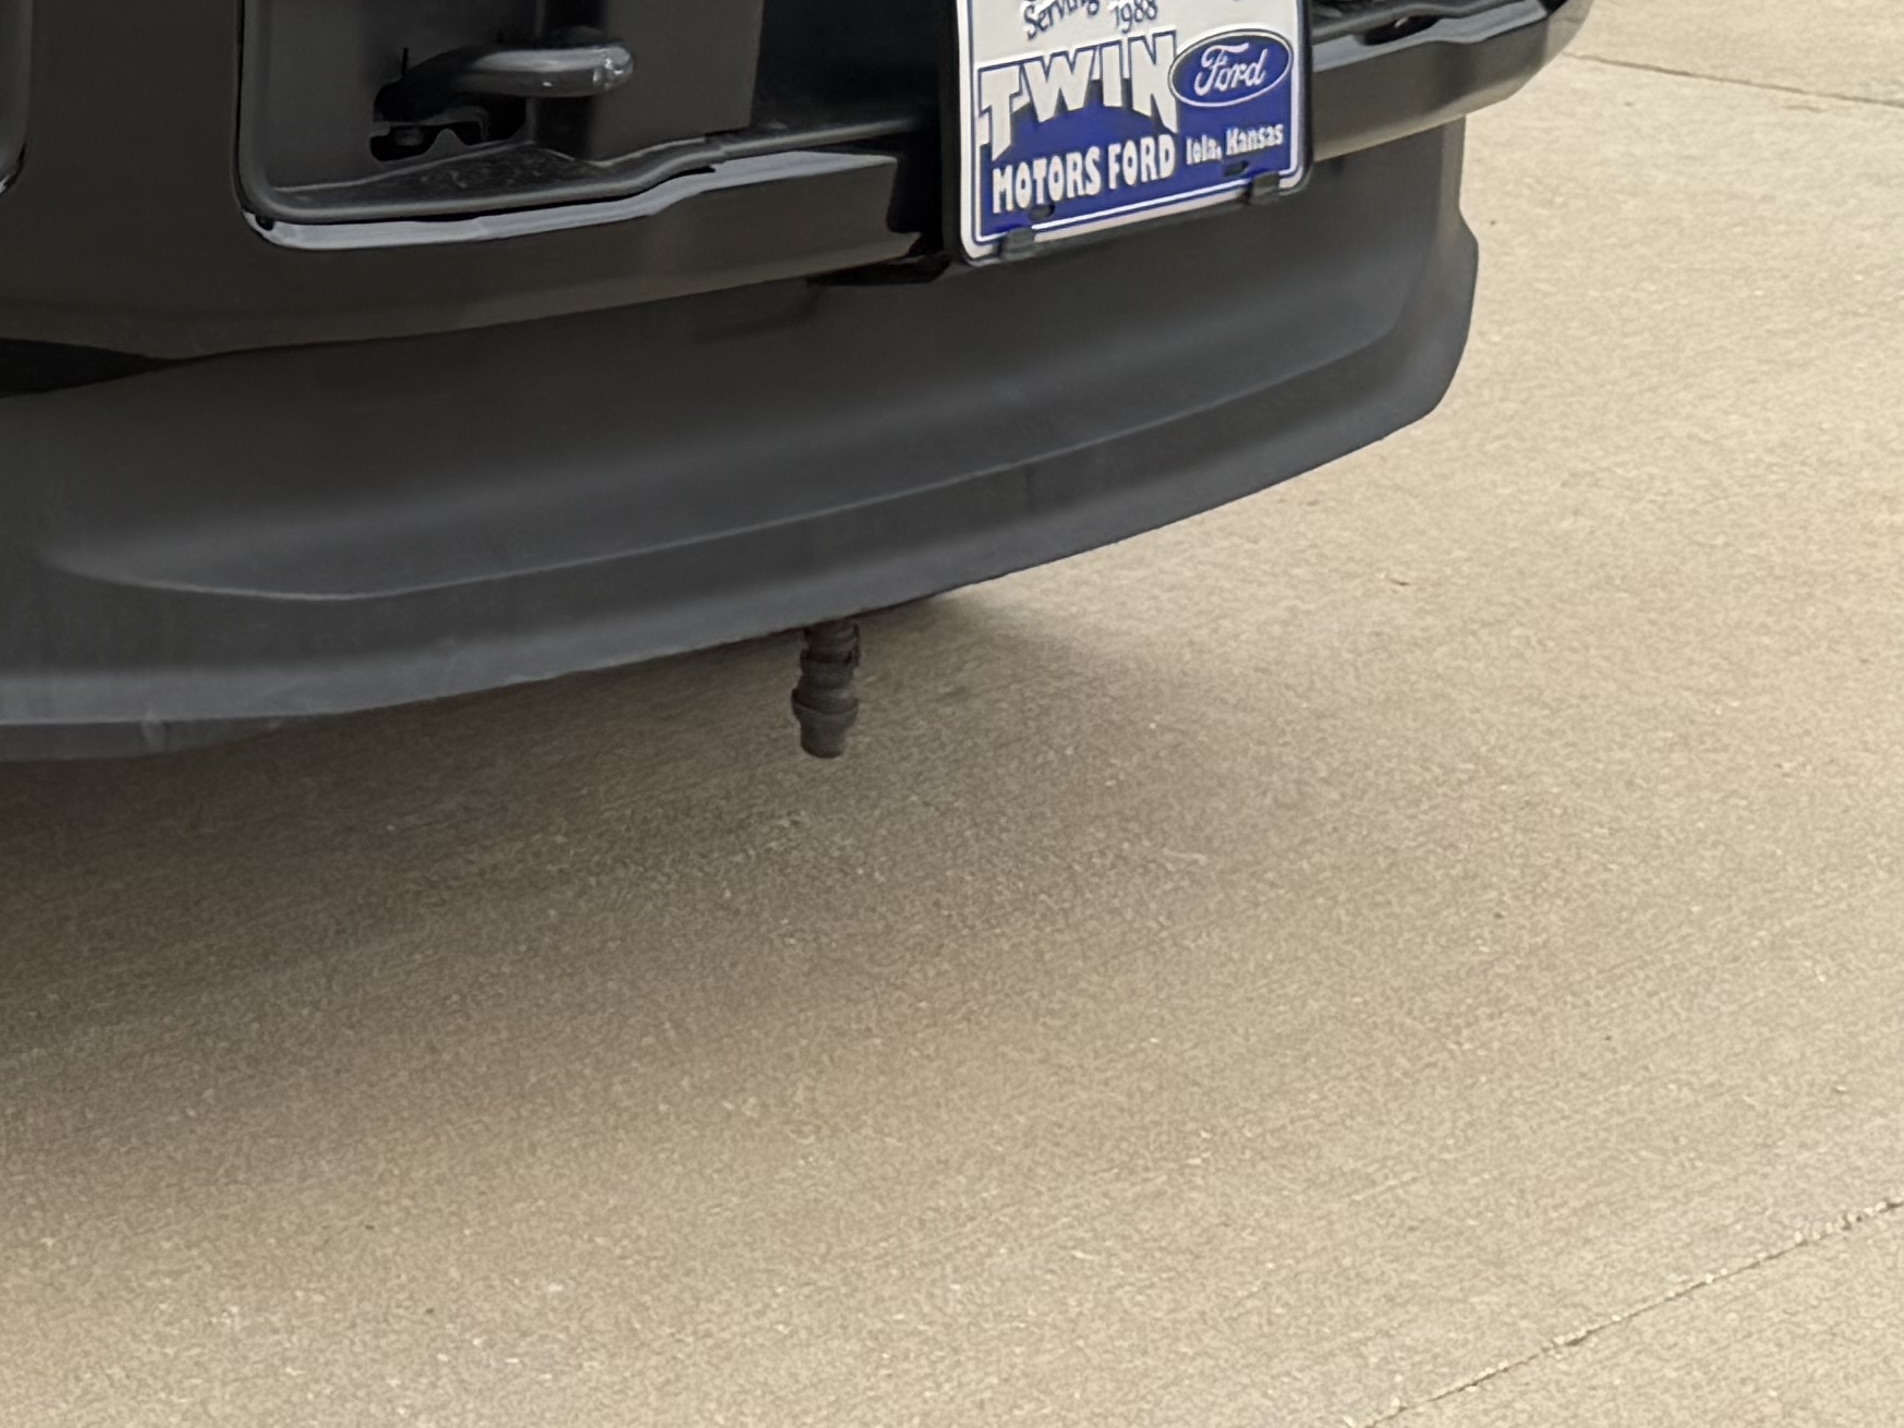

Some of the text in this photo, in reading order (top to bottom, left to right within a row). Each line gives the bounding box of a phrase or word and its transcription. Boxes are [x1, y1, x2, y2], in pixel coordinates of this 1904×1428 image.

[977, 30, 1178, 161] TWIN
[1194, 43, 1267, 96] Ford
[1226, 122, 1283, 157] Kansas
[993, 134, 1175, 214] MOTORS FORD
